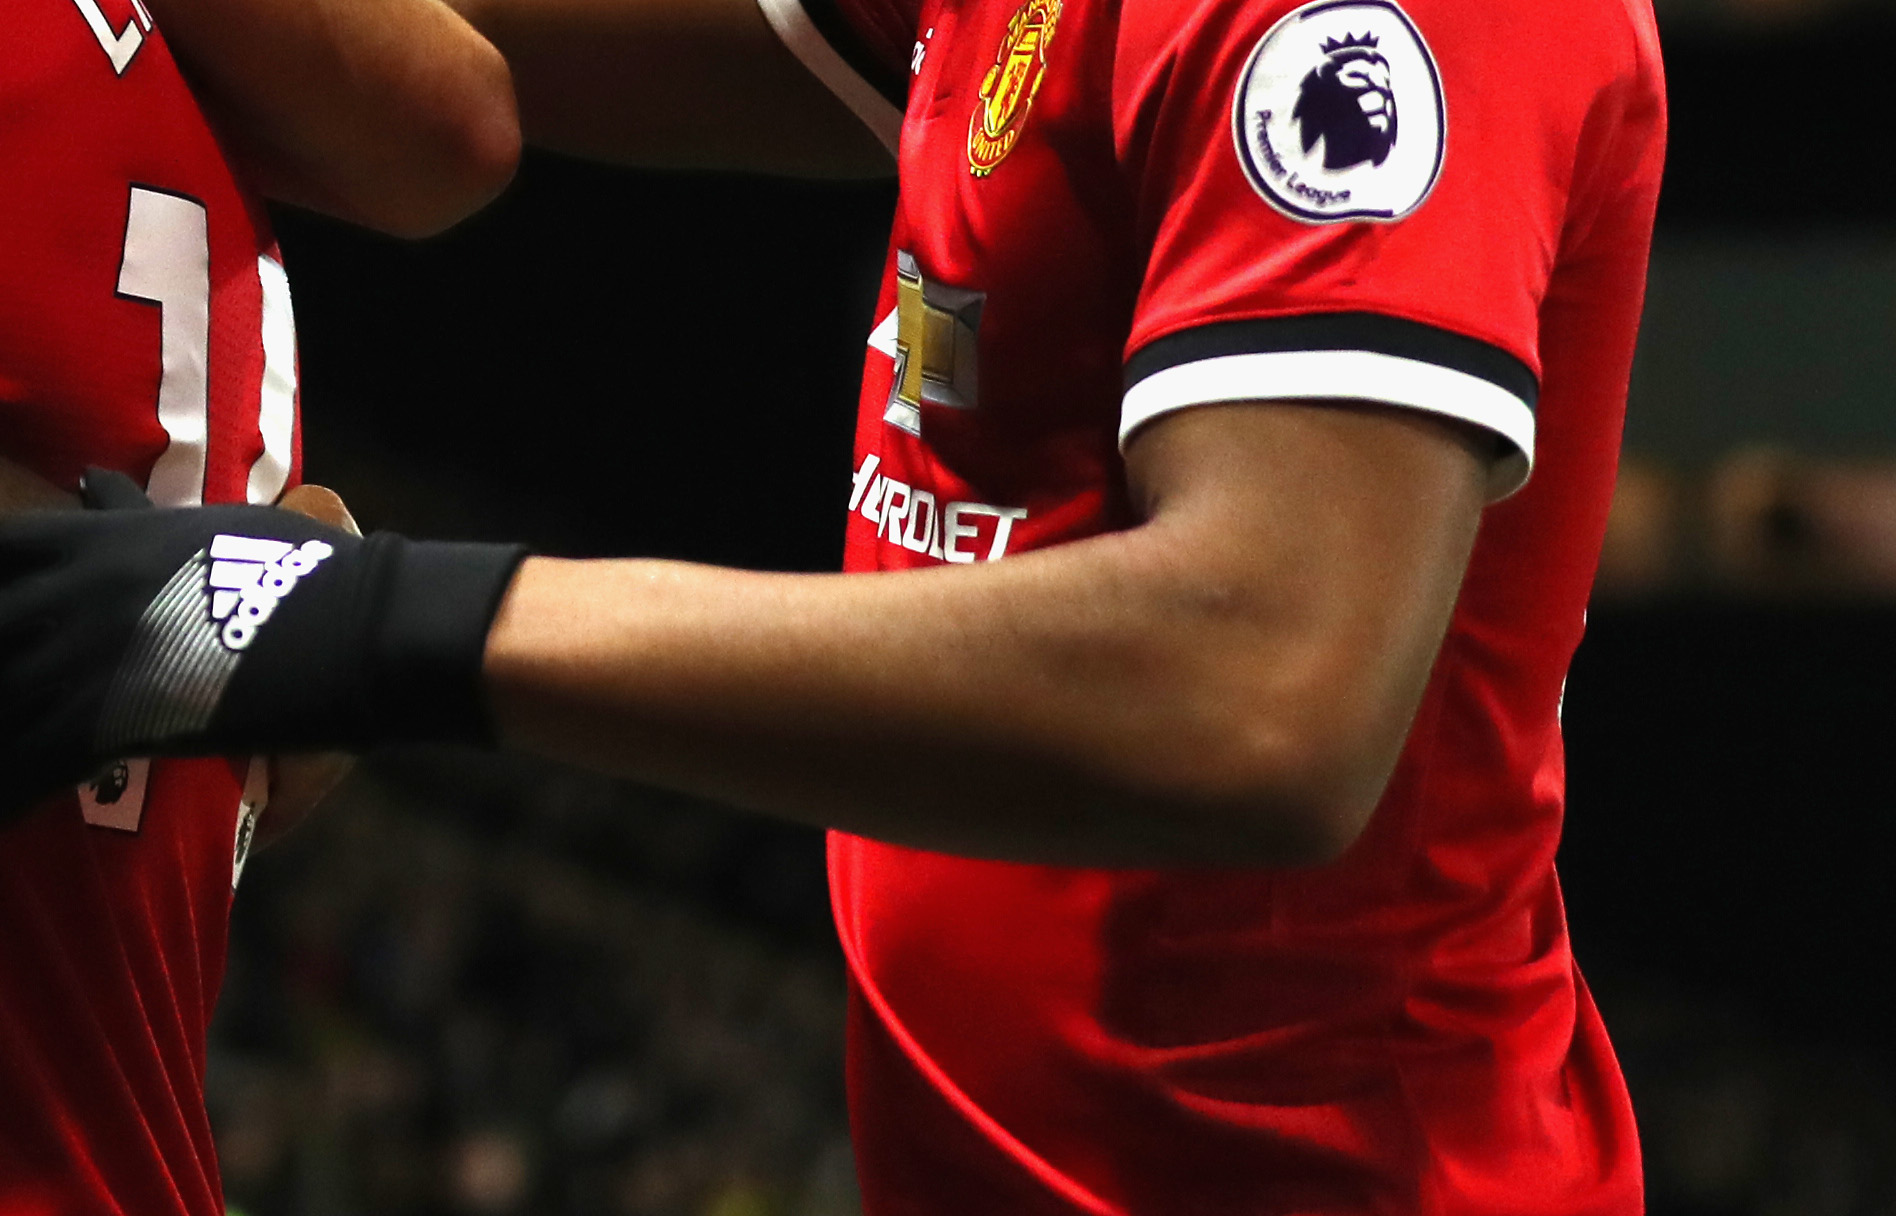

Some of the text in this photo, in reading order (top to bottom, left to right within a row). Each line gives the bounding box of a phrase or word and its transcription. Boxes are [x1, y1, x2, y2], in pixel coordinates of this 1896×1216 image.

[972, 127, 1015, 161] UNITED
[1255, 109, 1352, 208] Premier League
[221, 539, 335, 650] adidas
